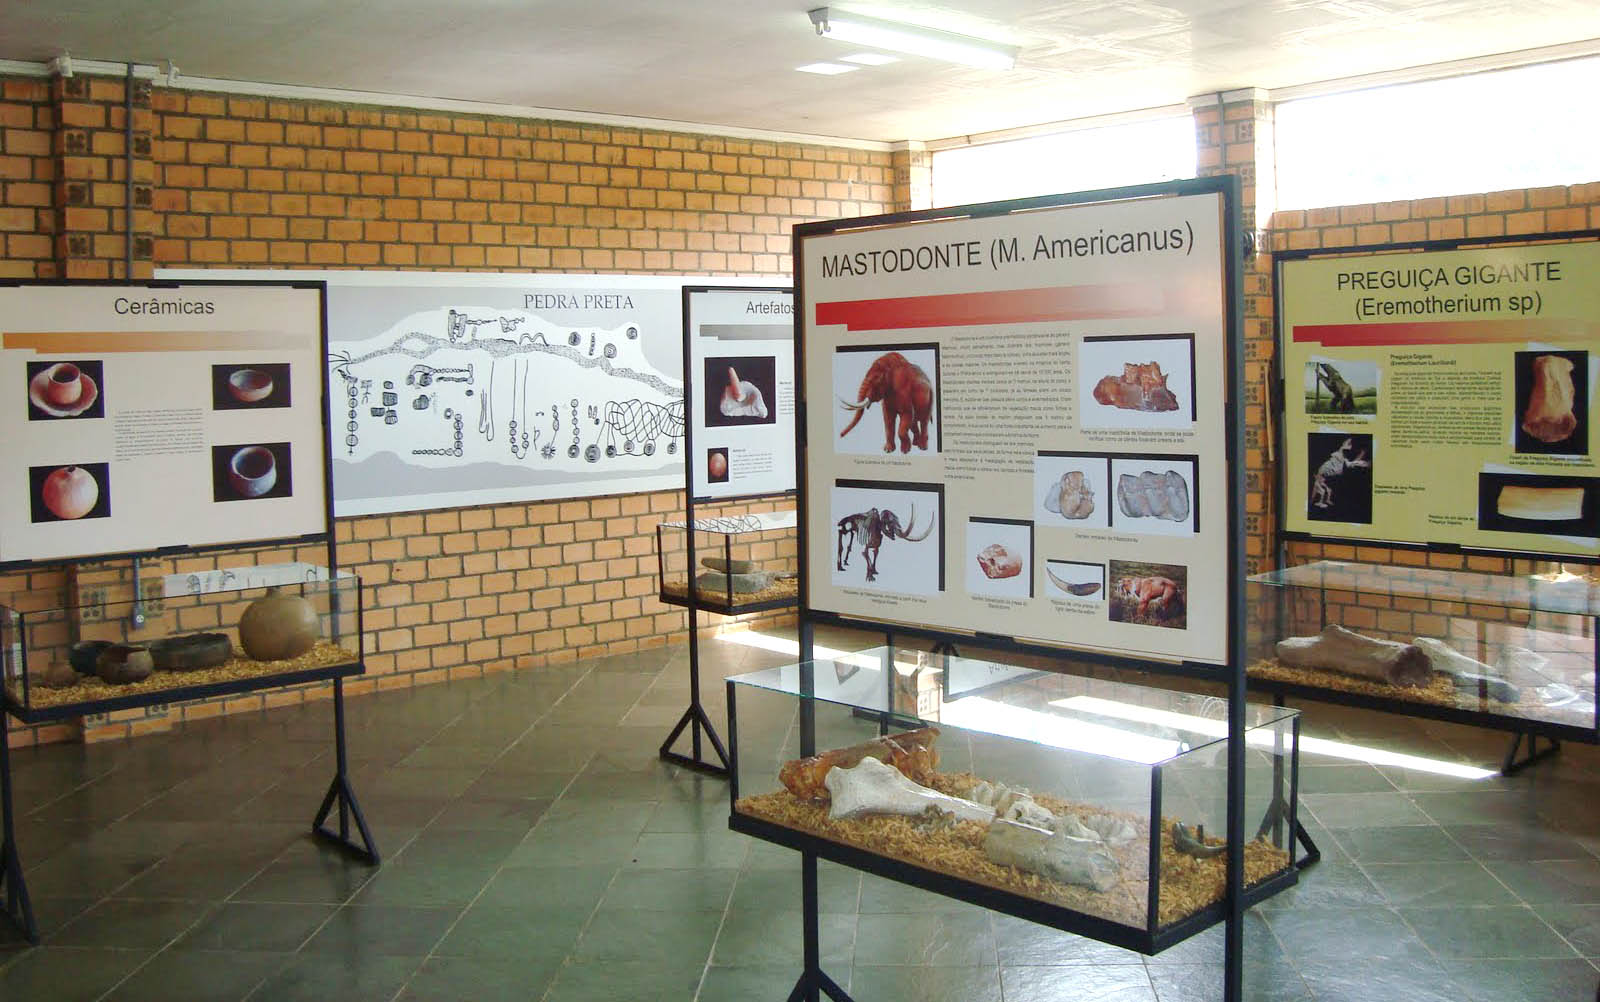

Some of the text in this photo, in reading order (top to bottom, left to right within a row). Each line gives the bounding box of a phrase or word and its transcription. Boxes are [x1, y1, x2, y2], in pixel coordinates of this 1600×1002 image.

[822, 220, 1194, 279] MASTODONTE (M. Americanus)
[1337, 261, 1562, 292] PREGUIÇA GIGANTE
[114, 297, 215, 315] Cerâmicas
[523, 293, 634, 310] PEDRA PRETA
[745, 300, 795, 314] Artefatos
[1355, 290, 1542, 321] (Eremotherium sp)
